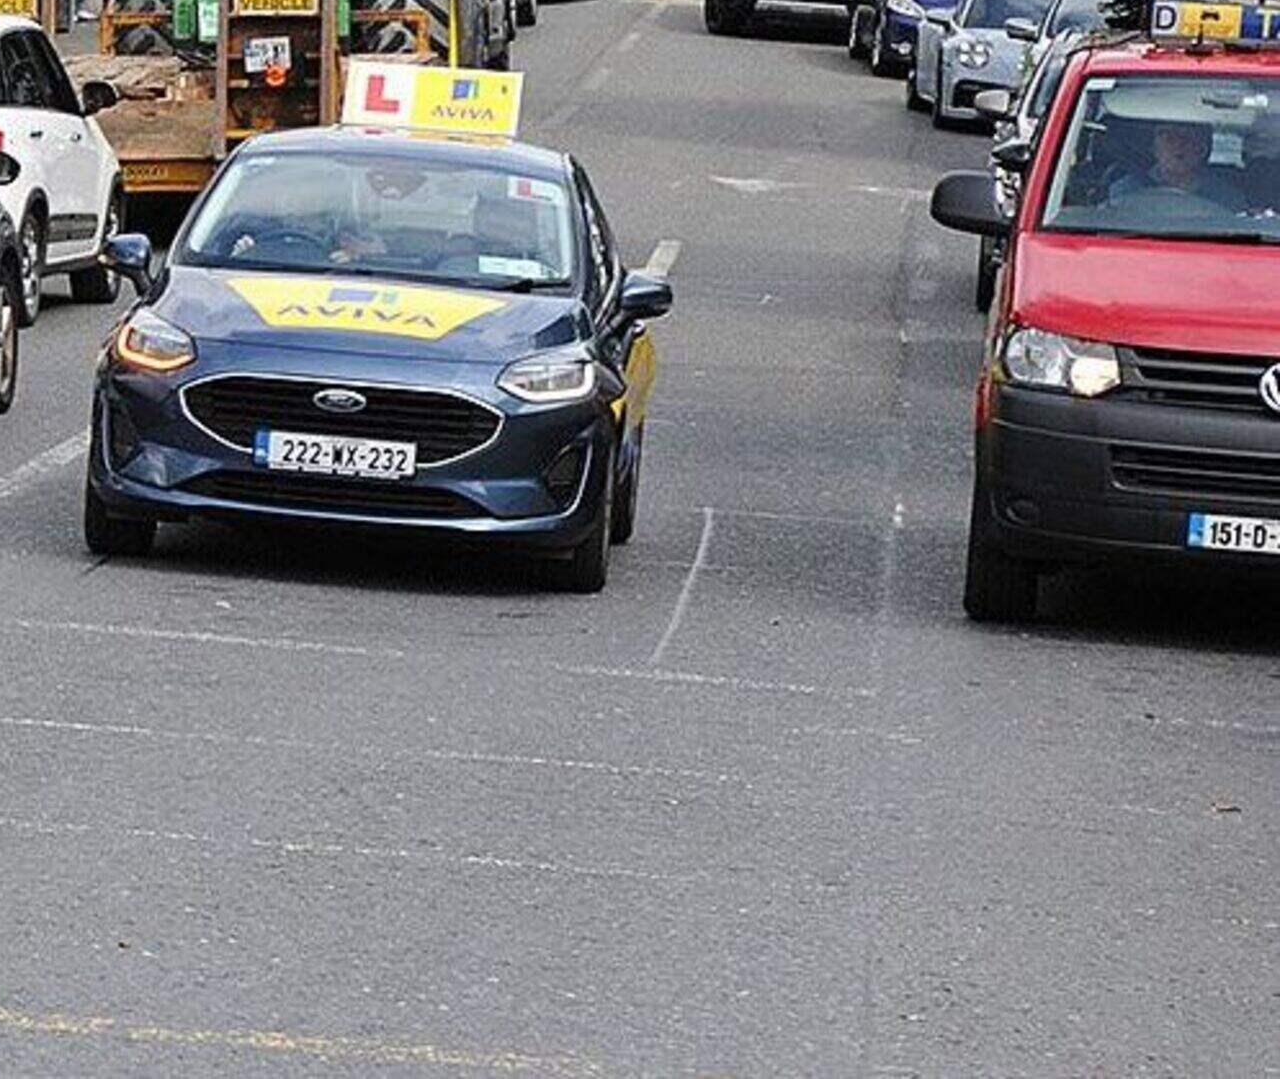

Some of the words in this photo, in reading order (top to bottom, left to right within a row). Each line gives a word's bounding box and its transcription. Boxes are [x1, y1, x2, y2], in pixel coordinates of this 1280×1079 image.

[1156, 5, 1177, 31] D
[365, 74, 400, 113] L
[432, 104, 495, 121] AVIVA
[277, 303, 436, 329] AVIVA
[282, 439, 408, 472] 222-WX-232
[1210, 521, 1280, 550] 151-D-
